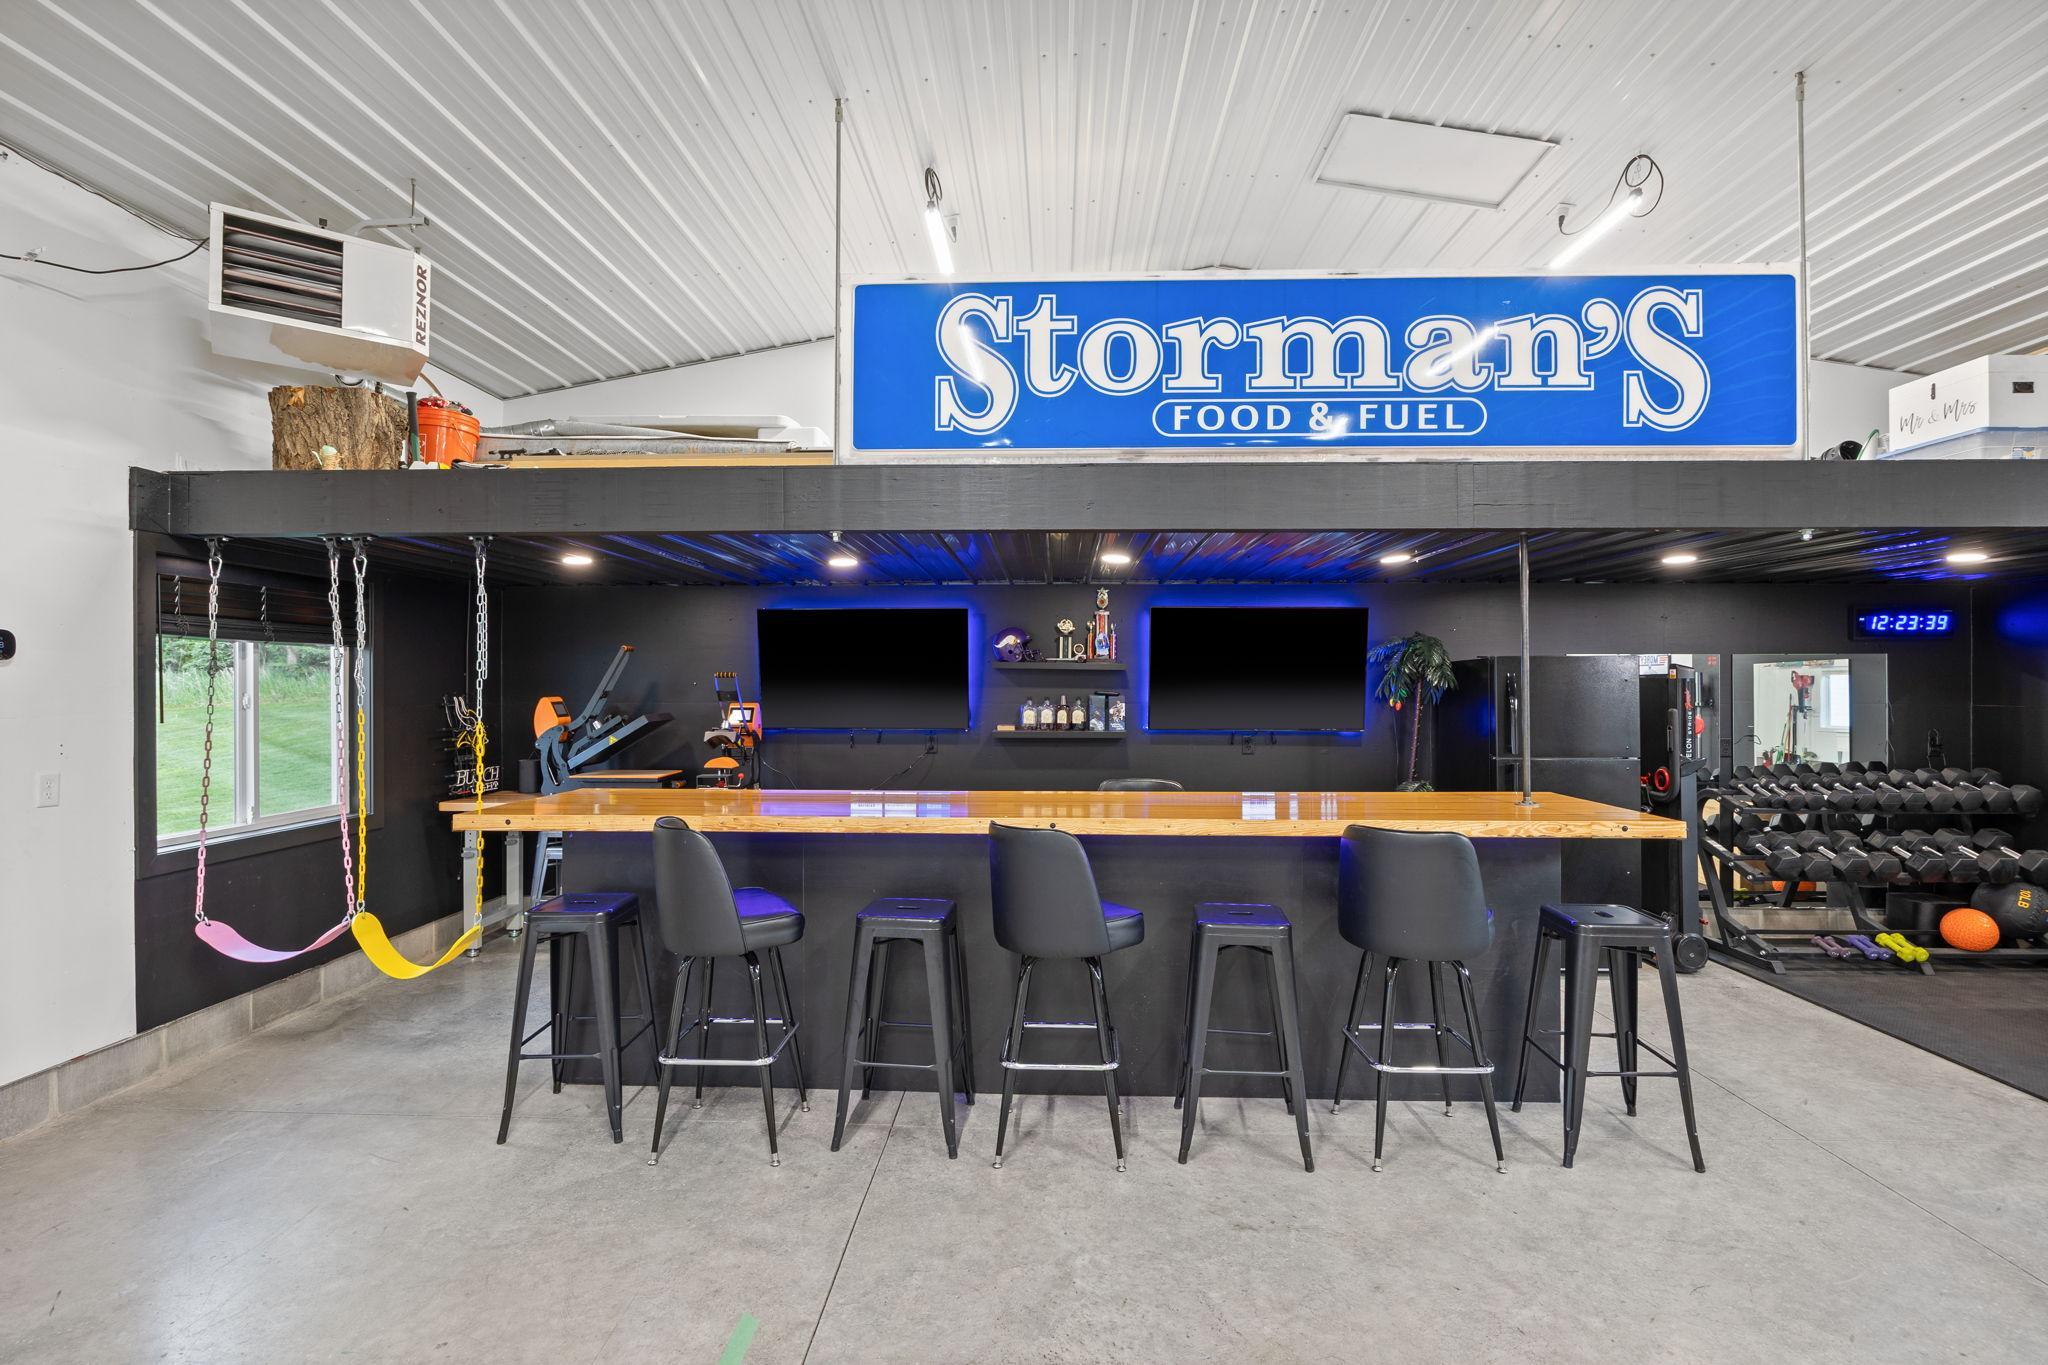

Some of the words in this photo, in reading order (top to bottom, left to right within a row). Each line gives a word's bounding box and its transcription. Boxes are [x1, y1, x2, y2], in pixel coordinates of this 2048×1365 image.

[415, 264, 428, 347] REZNOR
[1172, 404, 1292, 431] FOOD
[1308, 402, 1335, 432] &
[1358, 403, 1465, 430] FUEL
[1899, 412, 1924, 435] Mr
[1927, 409, 1938, 425] &
[1943, 399, 1976, 422] Mrs
[1871, 615, 1948, 630] 12:23:39
